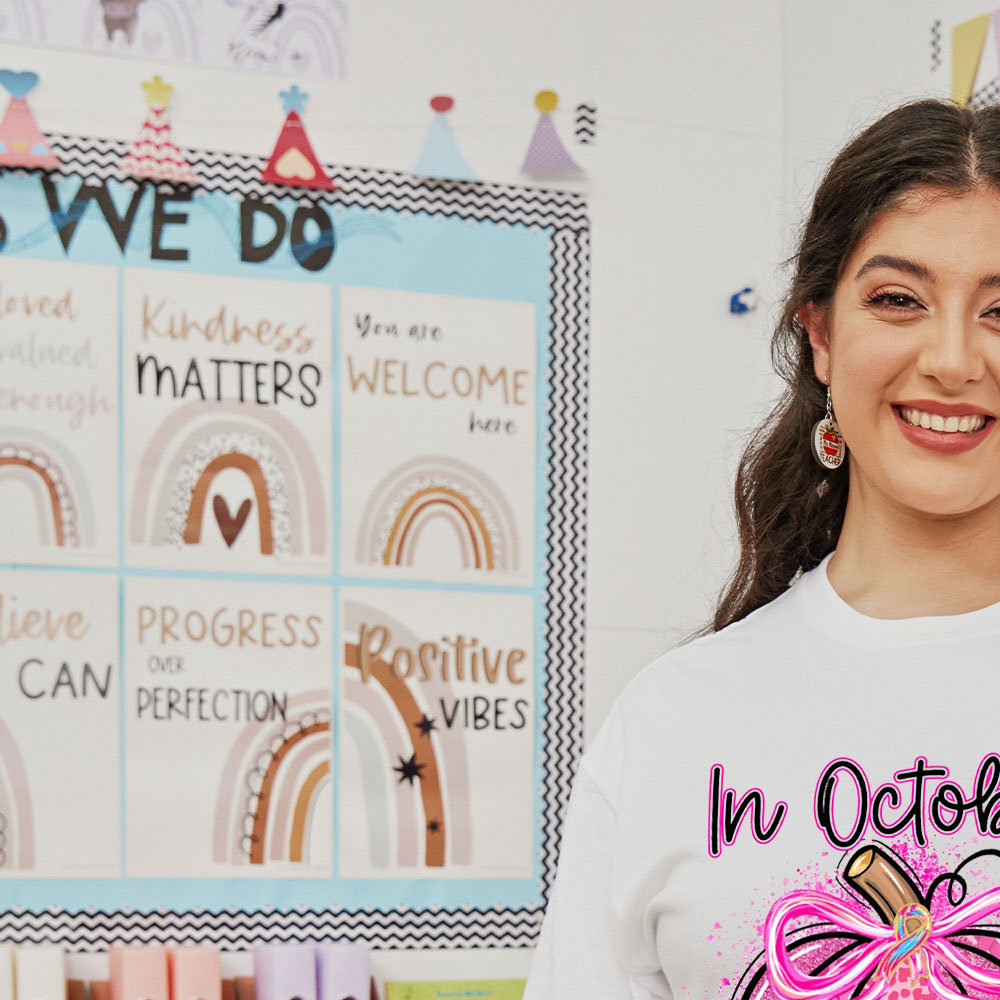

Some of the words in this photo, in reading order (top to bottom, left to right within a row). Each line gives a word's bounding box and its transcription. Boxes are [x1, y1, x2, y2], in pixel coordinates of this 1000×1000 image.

[40, 174, 194, 261] WE
[239, 195, 337, 272] DO
[142, 296, 316, 354] Kindness
[356, 312, 398, 339] You
[408, 323, 444, 342] are
[347, 353, 529, 406] WELCOME
[469, 410, 517, 435] here
[138, 605, 323, 648] PROGRESS
[149, 655, 186, 675] OVER
[359, 622, 527, 685] Positive
[18, 658, 112, 699] CAN
[136, 686, 288, 722] PERFECTION
[440, 696, 529, 730] VIBES
[708, 763, 788, 857] In
